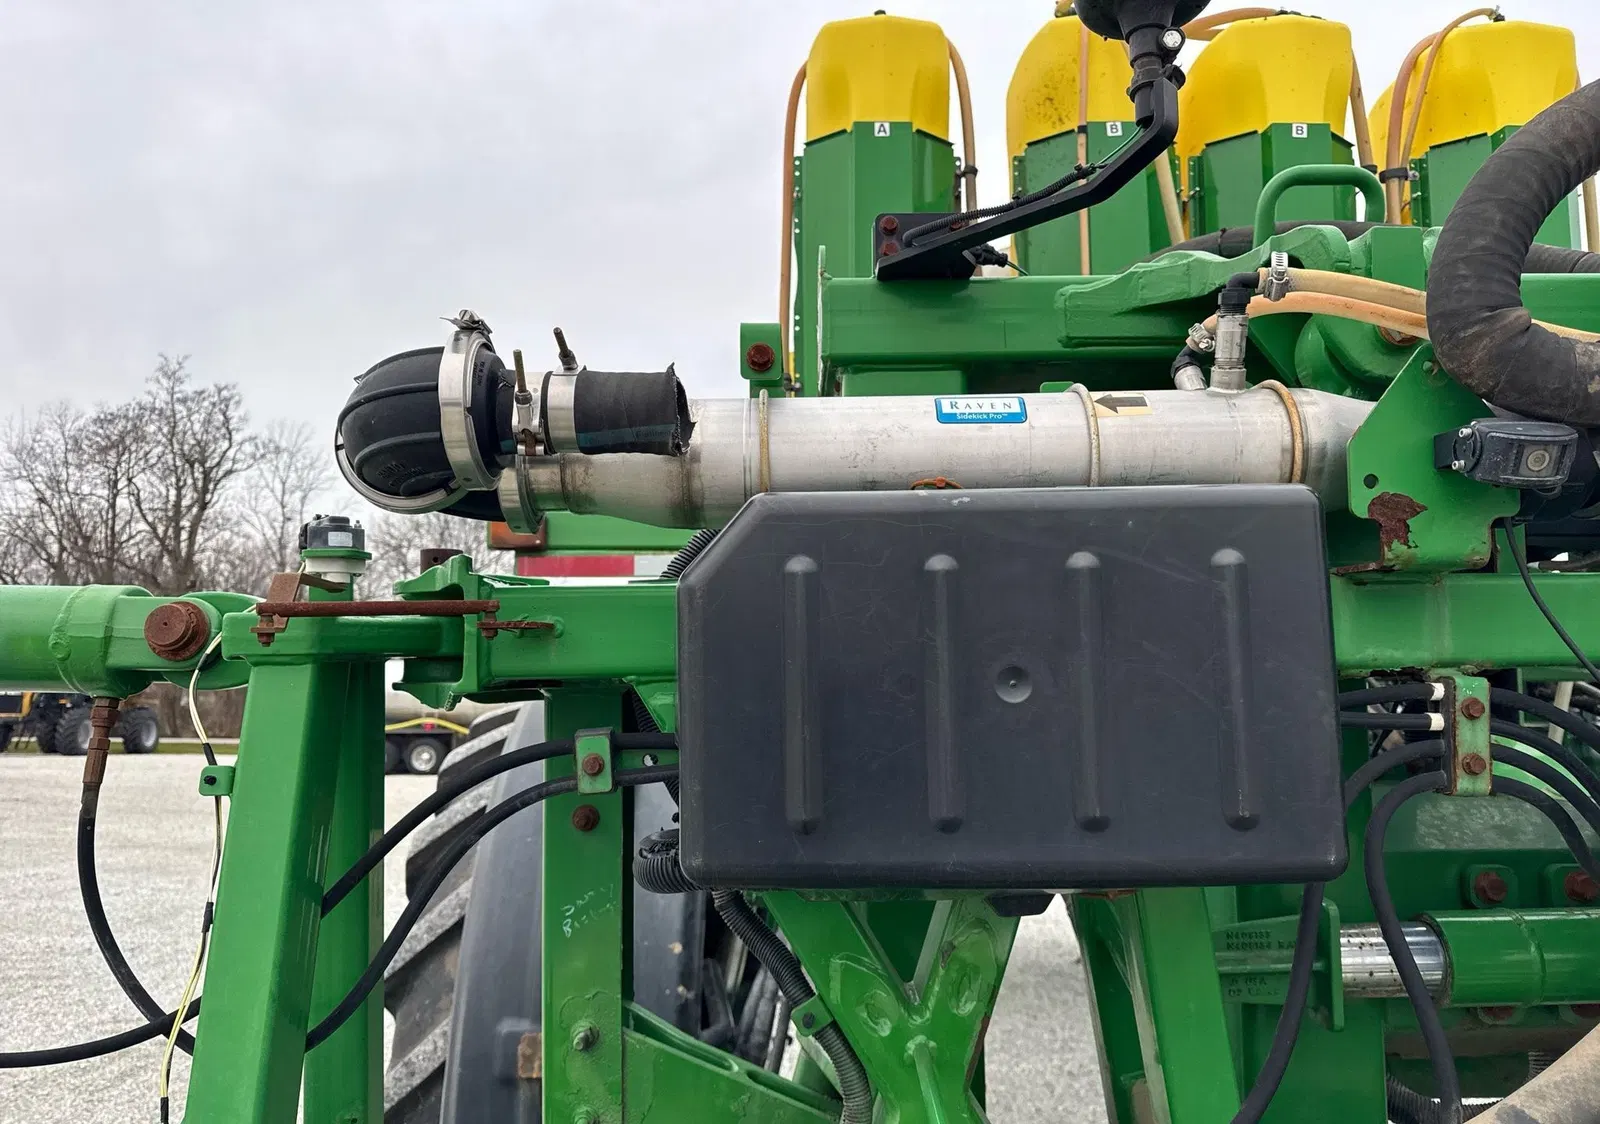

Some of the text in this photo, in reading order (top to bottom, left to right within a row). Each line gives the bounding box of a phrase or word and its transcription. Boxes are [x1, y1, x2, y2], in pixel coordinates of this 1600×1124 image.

[877, 123, 887, 135] A
[1110, 123, 1119, 134] B
[1295, 125, 1305, 136] B
[949, 401, 1012, 410] RAVEN
[956, 412, 988, 420] Sidekick
